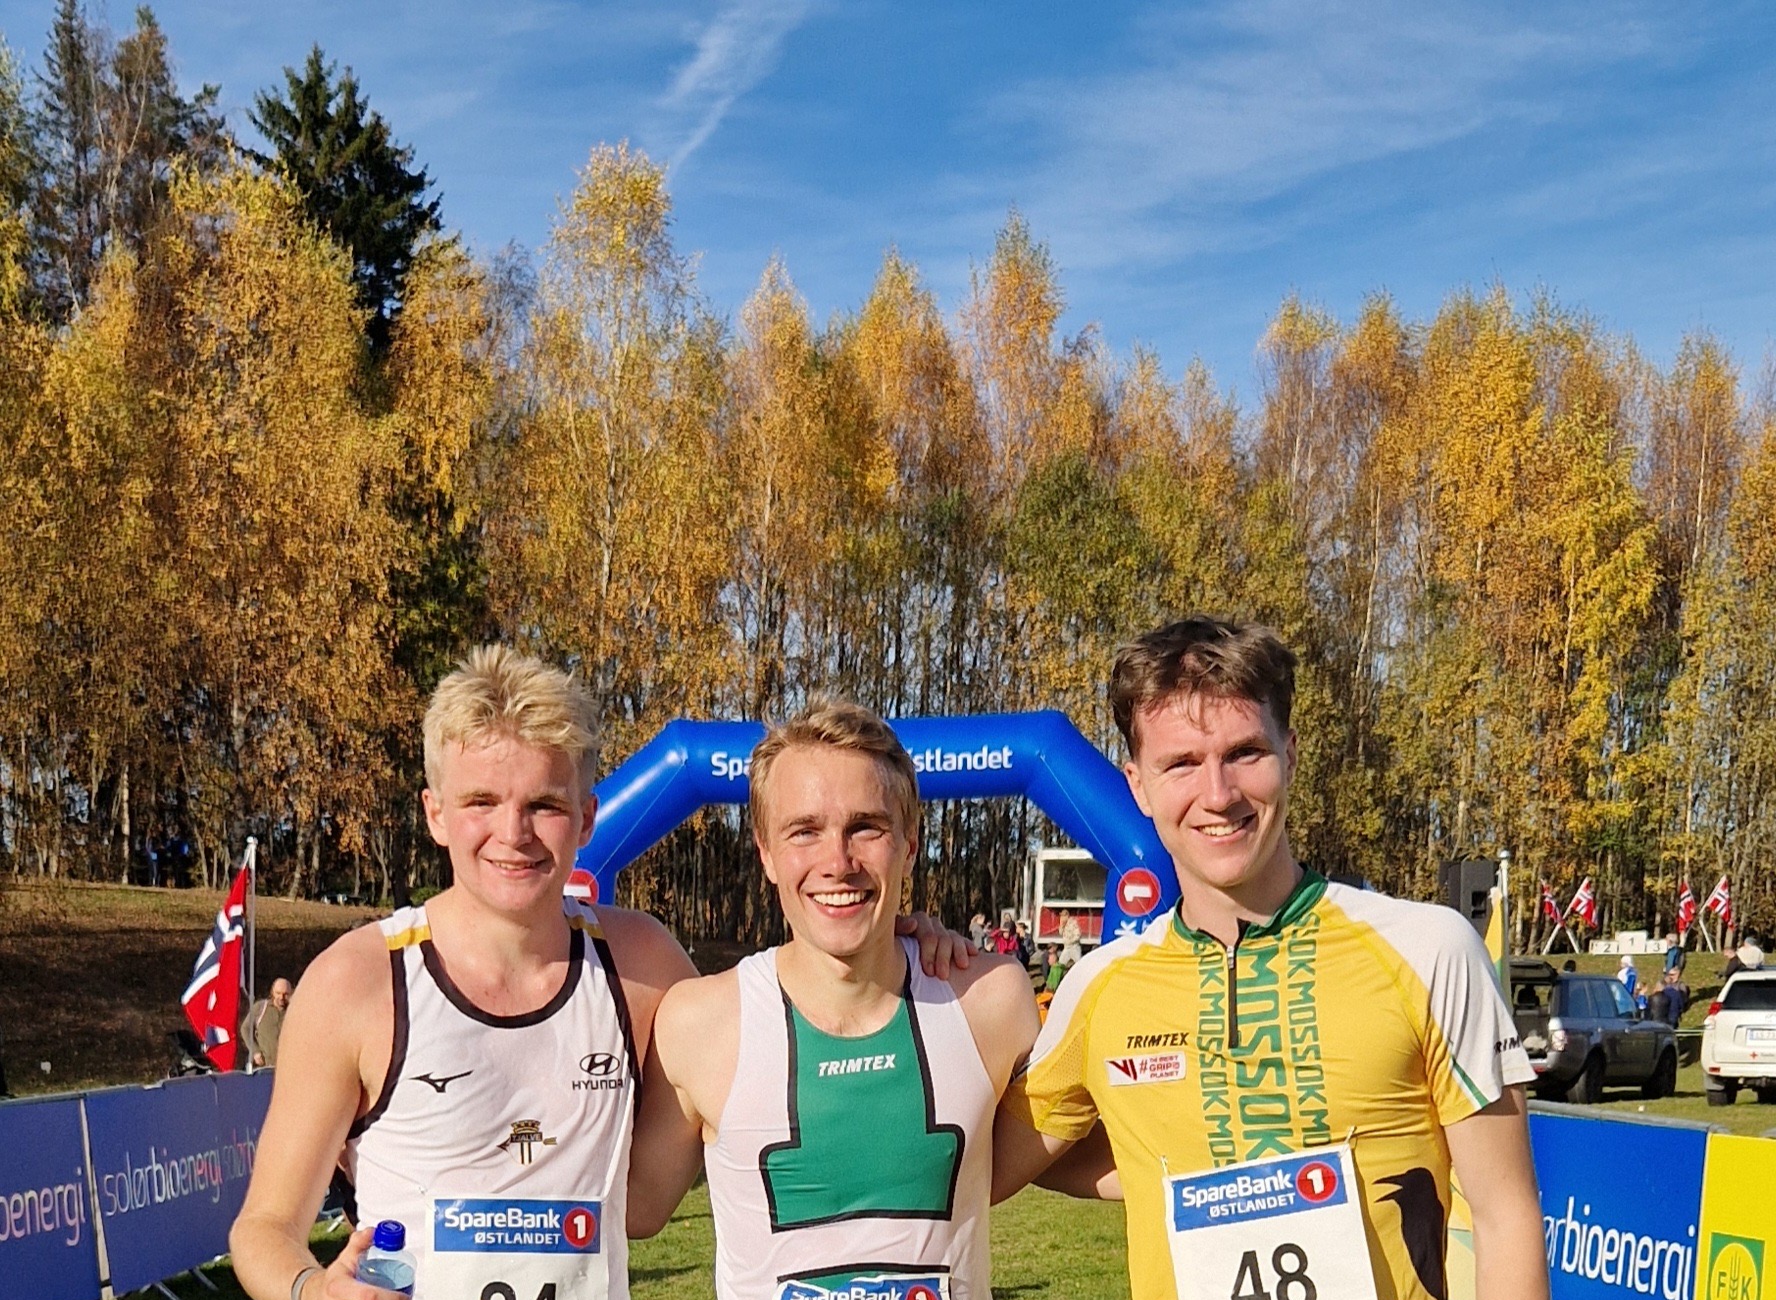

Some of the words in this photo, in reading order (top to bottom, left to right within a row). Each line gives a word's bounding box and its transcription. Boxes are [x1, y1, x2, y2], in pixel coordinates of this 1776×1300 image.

[907, 744, 1013, 773] stlandet
[1126, 1032, 1190, 1049] TRIMTEX
[818, 1054, 896, 1078] TRIMTEX
[1182, 1169, 1293, 1208] SpareBank
[1306, 1168, 1325, 1195] 1
[1209, 1192, 1296, 1218] ØSTLANDET
[444, 1208, 561, 1231] SpareBank
[573, 1215, 587, 1239] 1
[474, 1231, 562, 1245] ØSTLANDET
